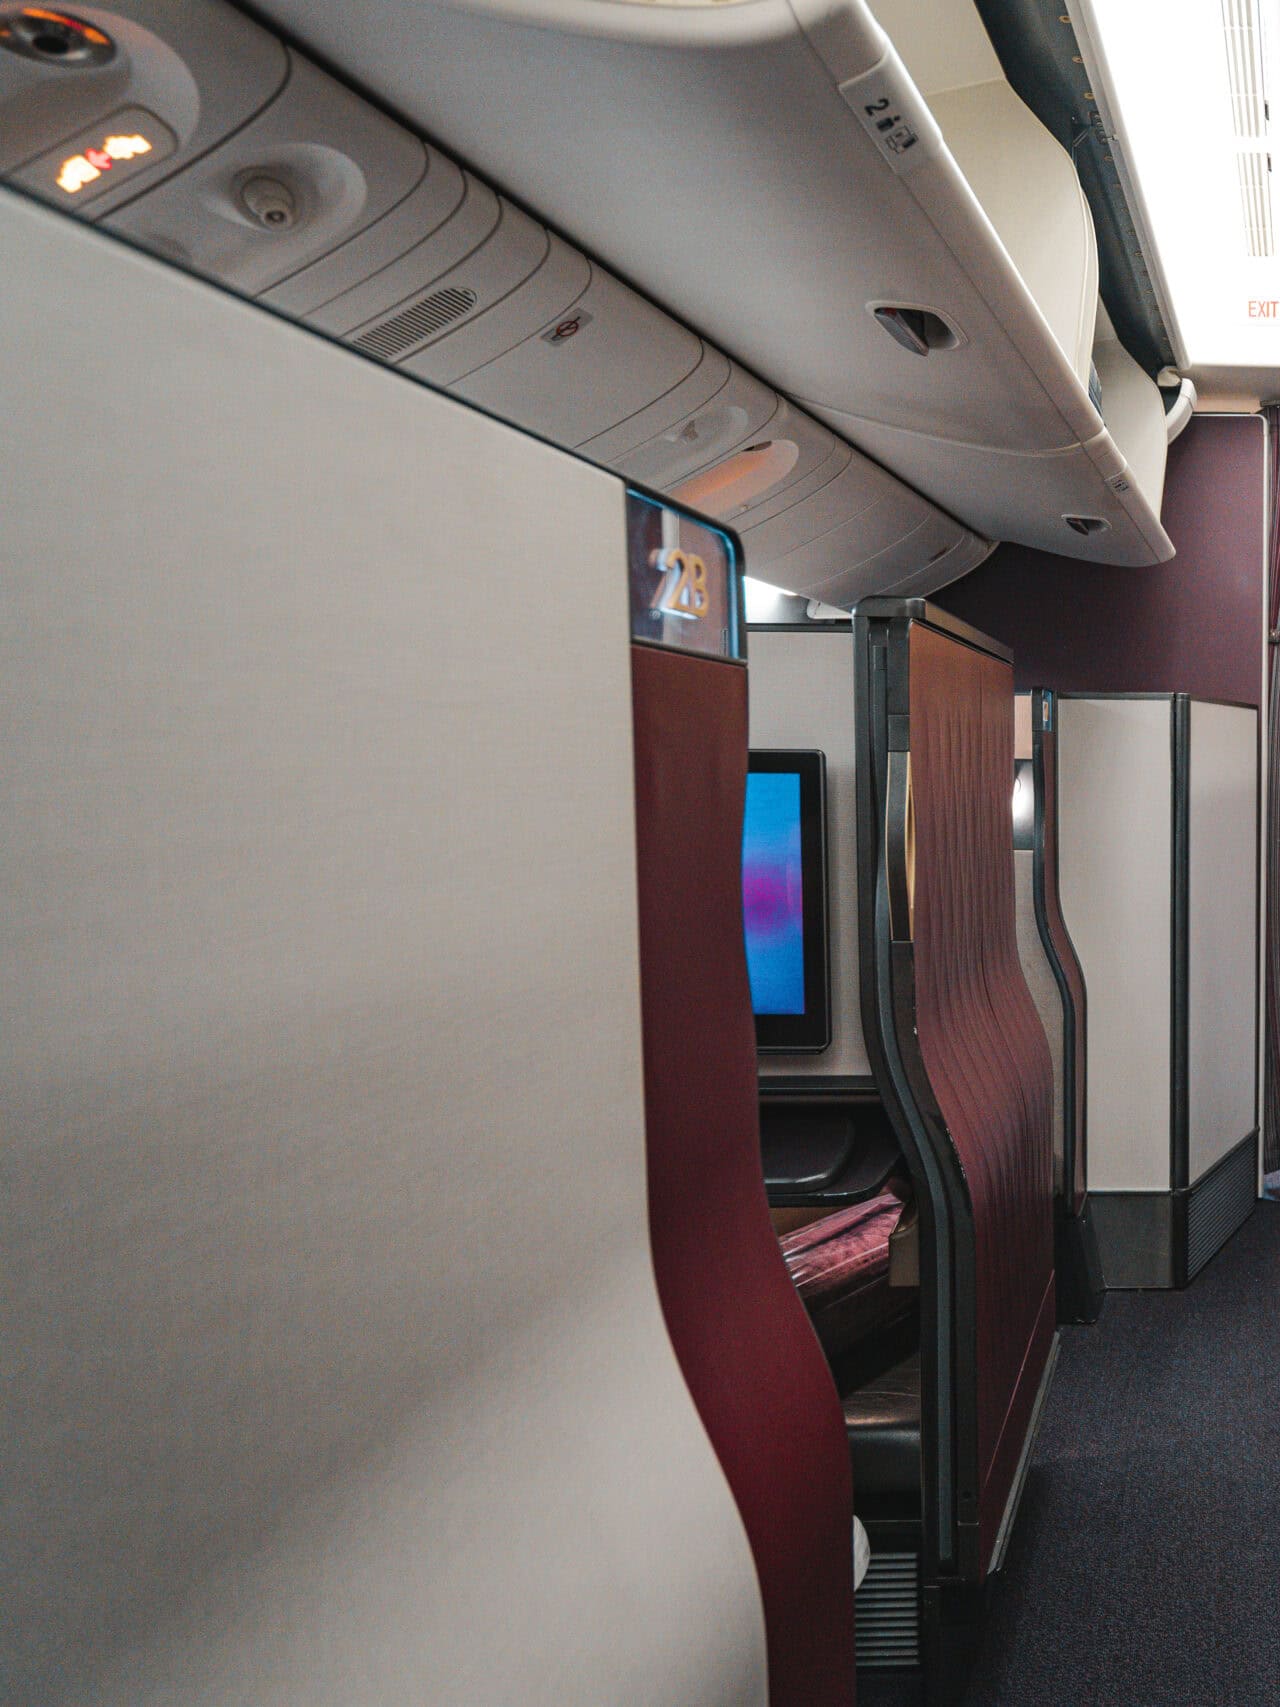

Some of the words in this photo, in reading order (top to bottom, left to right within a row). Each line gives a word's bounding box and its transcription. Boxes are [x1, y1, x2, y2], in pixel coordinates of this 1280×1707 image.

[864, 98, 889, 116] 2
[1248, 301, 1279, 318] EXIT
[660, 548, 709, 618] 2B
